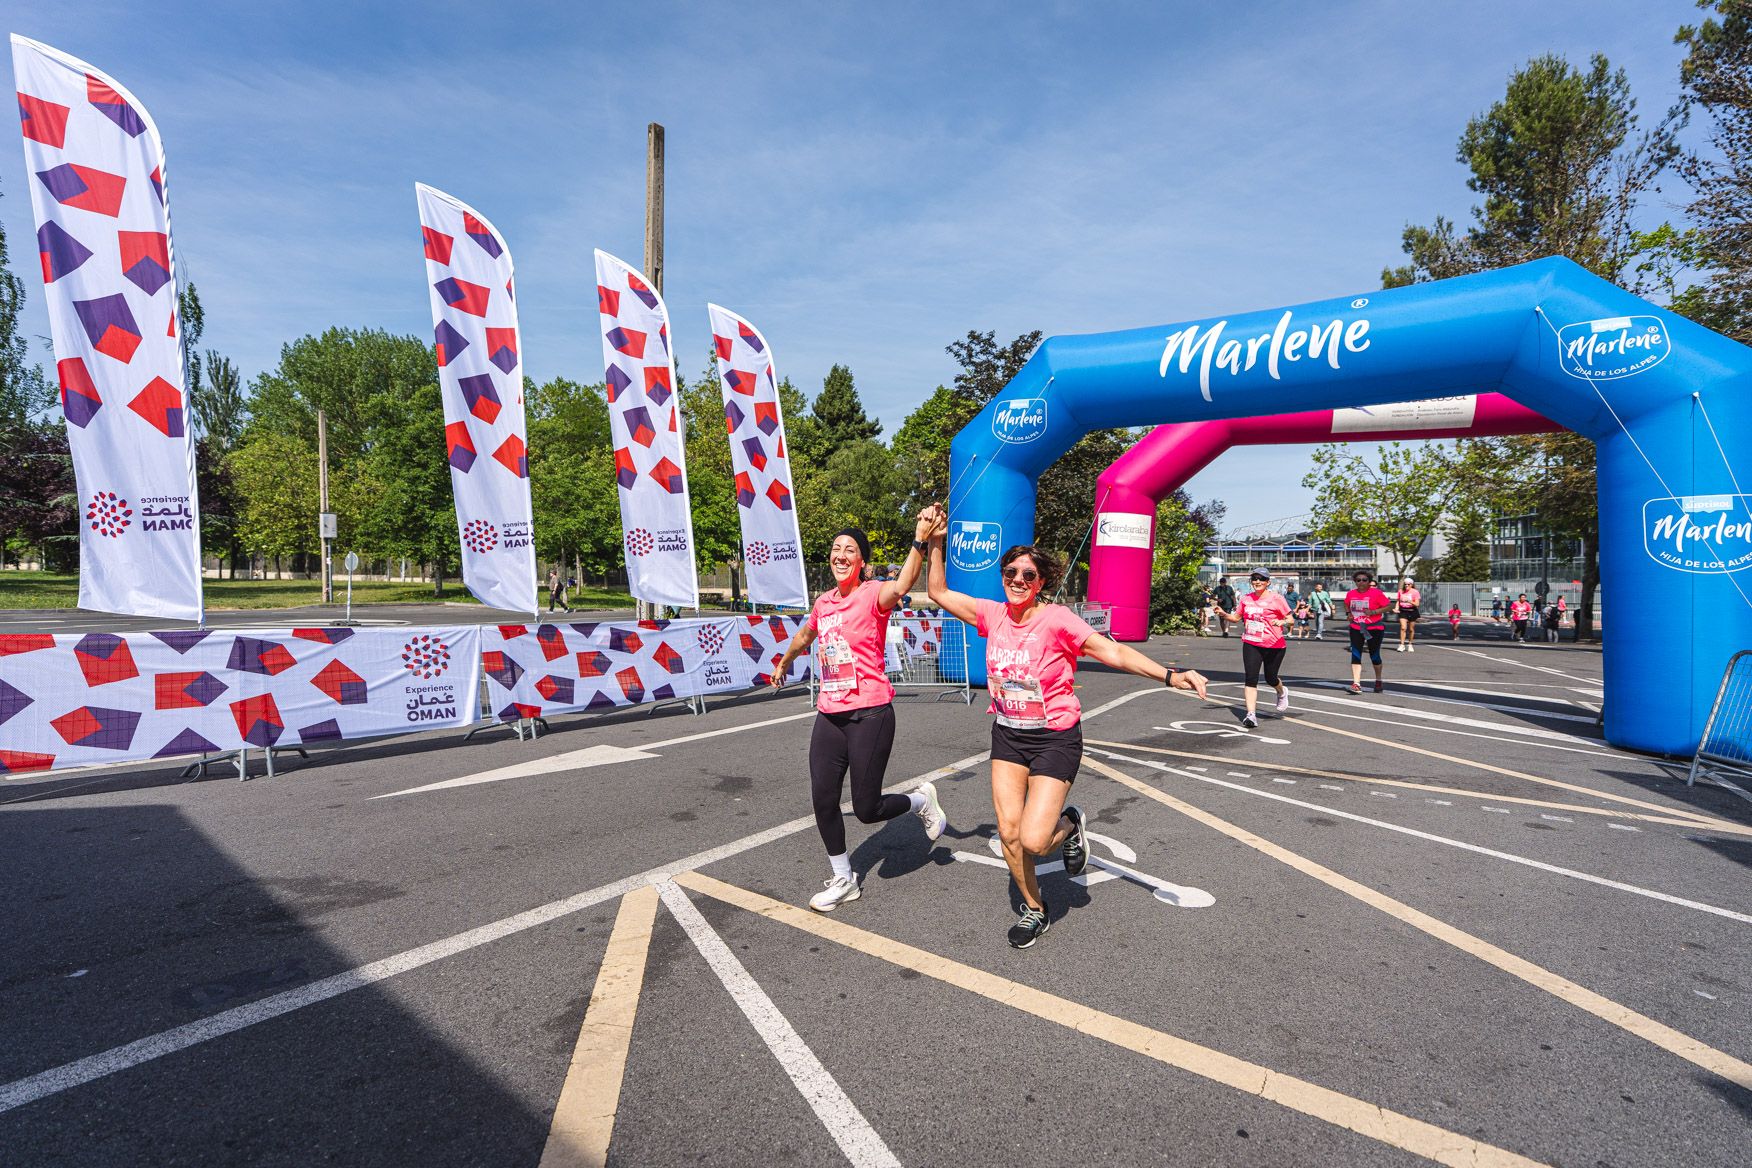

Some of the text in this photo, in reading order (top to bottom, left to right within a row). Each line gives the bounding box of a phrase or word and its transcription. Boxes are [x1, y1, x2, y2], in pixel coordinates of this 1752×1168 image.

[1160, 310, 1371, 402] Marlene
[1567, 329, 1662, 366] Marlene
[1574, 366, 1592, 376] HIJA
[1609, 368, 1628, 376] LOS
[1630, 354, 1658, 371] ALPES
[996, 409, 1043, 432] Marlene
[1652, 512, 1752, 553] Marlen
[952, 532, 996, 556] Marlene
[1660, 551, 1682, 565] HIJA
[406, 685, 454, 694] Experience
[706, 676, 732, 686] OMAN
[407, 707, 456, 721] OMAN
[1006, 700, 1026, 710] 016
